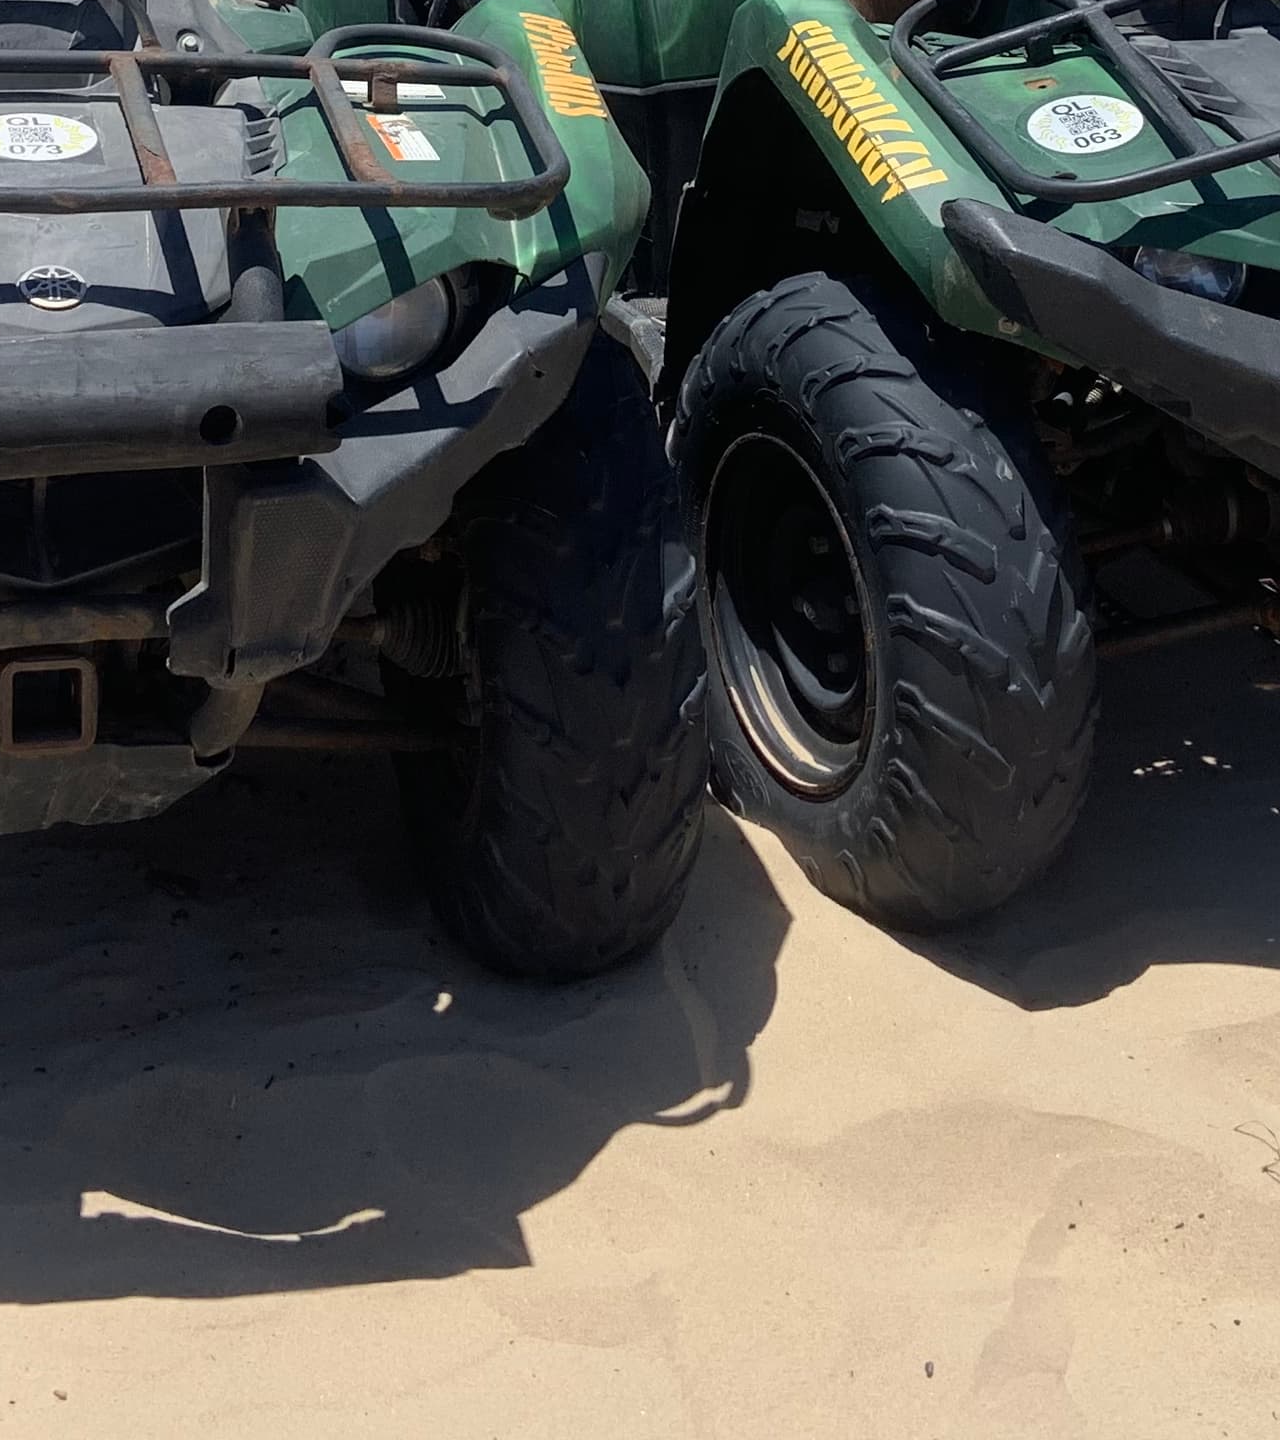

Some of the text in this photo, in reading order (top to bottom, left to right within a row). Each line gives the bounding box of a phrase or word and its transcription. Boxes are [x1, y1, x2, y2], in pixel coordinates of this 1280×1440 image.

[1051, 101, 1093, 117] QL
[5, 116, 51, 127] QL
[1073, 128, 1122, 148] 063
[8, 144, 63, 155] 073
